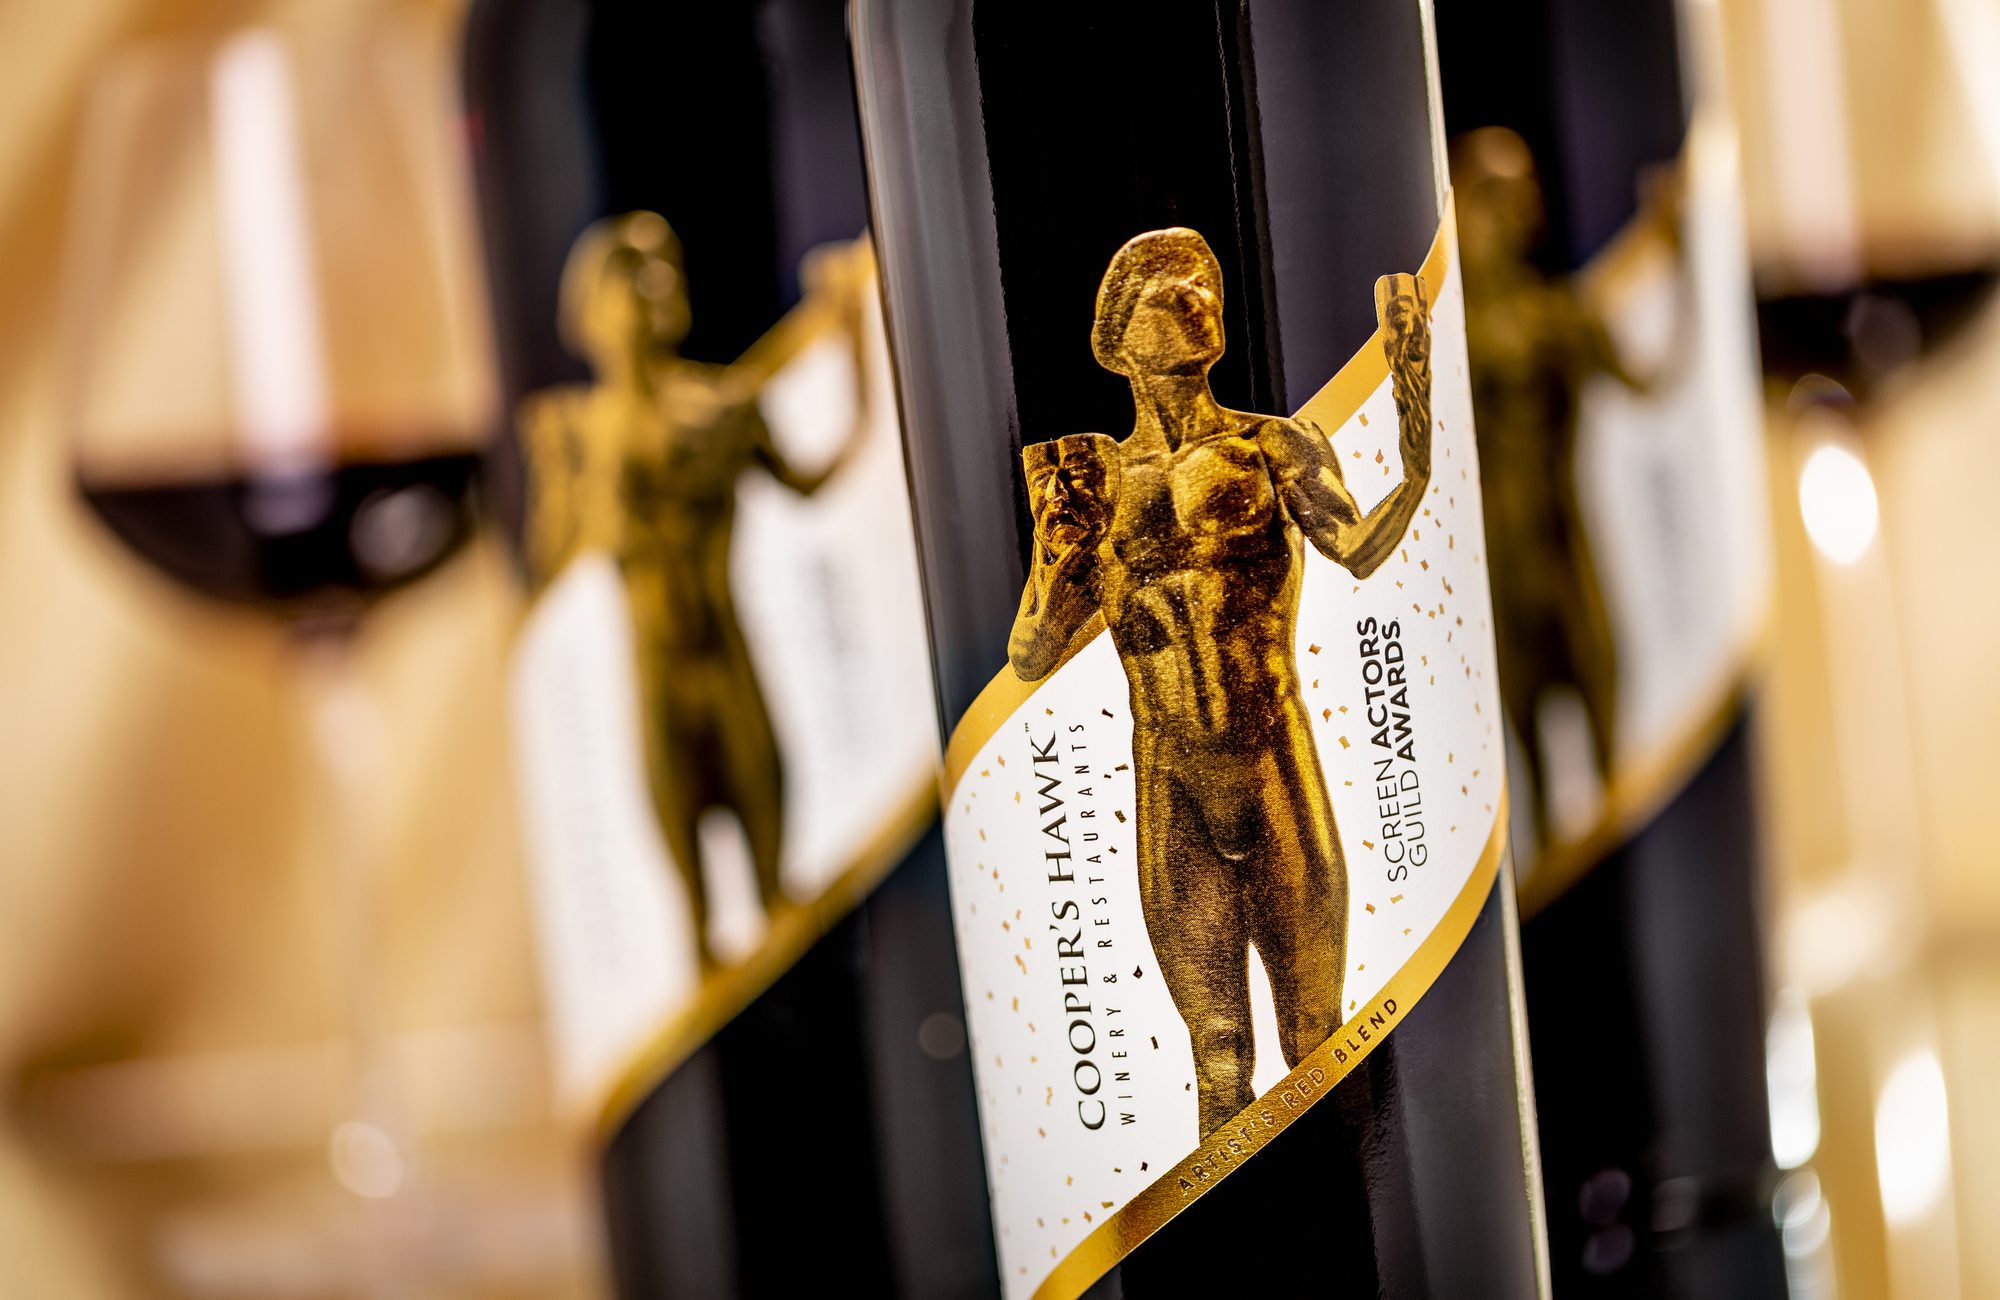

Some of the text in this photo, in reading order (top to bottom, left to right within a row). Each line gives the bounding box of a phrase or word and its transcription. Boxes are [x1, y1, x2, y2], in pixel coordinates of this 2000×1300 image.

[1356, 616, 1408, 882] SCREEN ACTORS
[1400, 769, 1428, 867] GUILD
[1049, 900, 1106, 1131] COOPER'S
[1068, 724, 1136, 1126] WINERY & RESTAURANTS
[1178, 998, 1398, 1195] ARTIST'S RED BLEND
